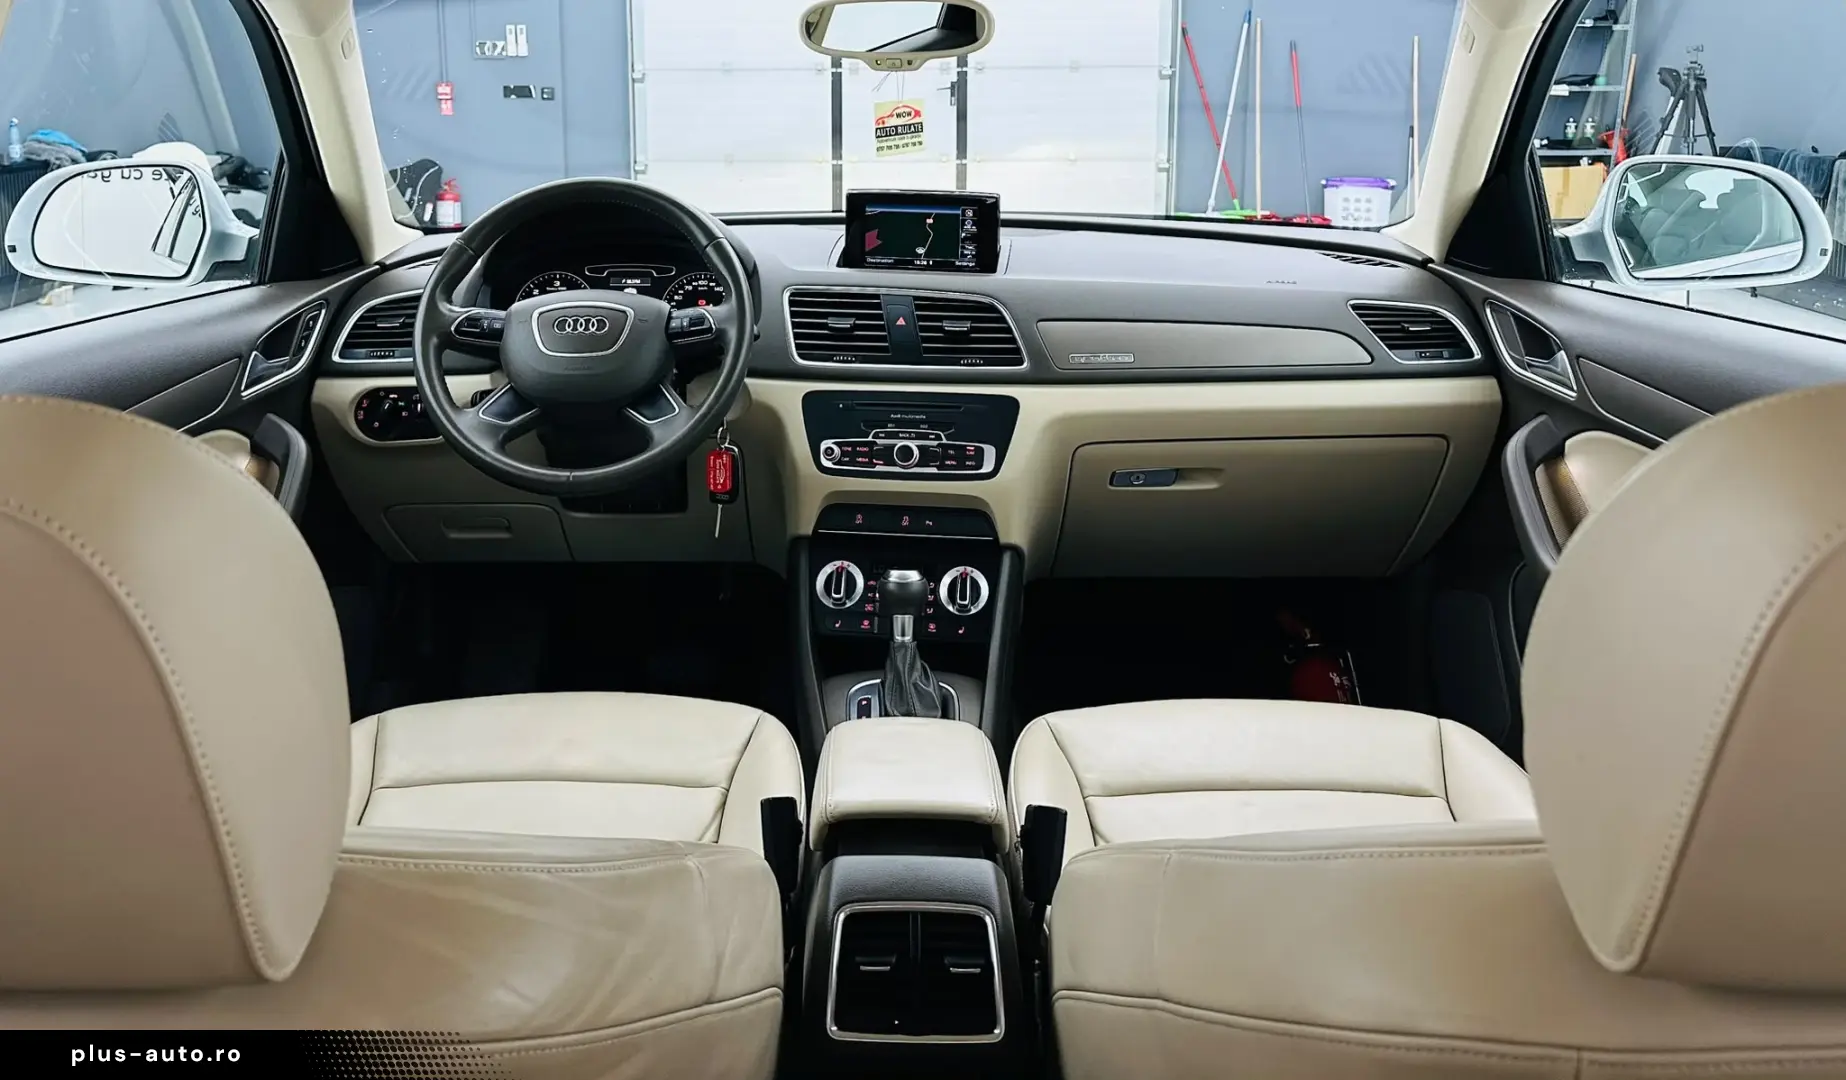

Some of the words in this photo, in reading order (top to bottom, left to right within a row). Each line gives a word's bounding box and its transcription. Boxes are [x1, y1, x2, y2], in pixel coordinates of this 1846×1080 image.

[895, 110, 913, 119] WOW
[876, 126, 896, 137] AUTO
[897, 123, 923, 135] RULATE
